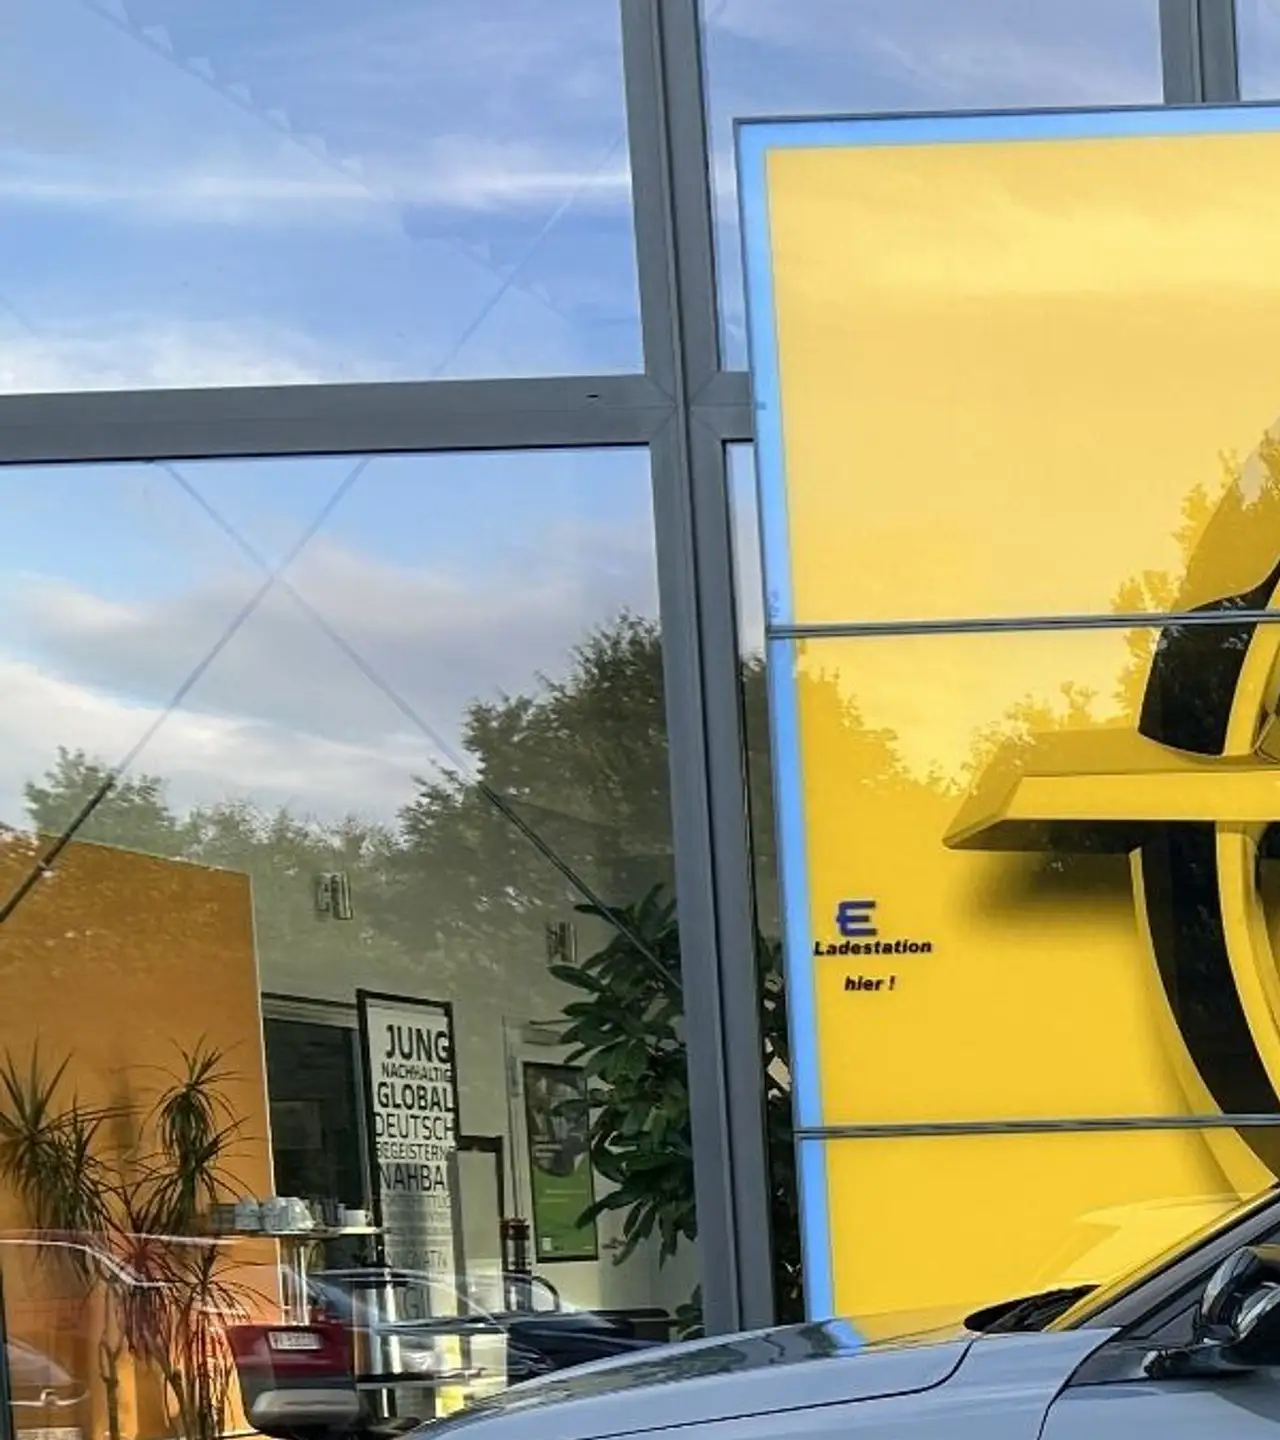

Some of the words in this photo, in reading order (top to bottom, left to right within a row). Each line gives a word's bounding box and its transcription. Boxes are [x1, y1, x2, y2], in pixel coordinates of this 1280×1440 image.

[836, 900, 879, 937] E
[813, 939, 933, 957] Ladestation
[844, 975, 883, 992] hier
[386, 1023, 450, 1064] JUNG
[377, 1081, 455, 1113] GLOBAL
[374, 1111, 456, 1142] DEUTSCH
[380, 1162, 447, 1194] NAHBA
